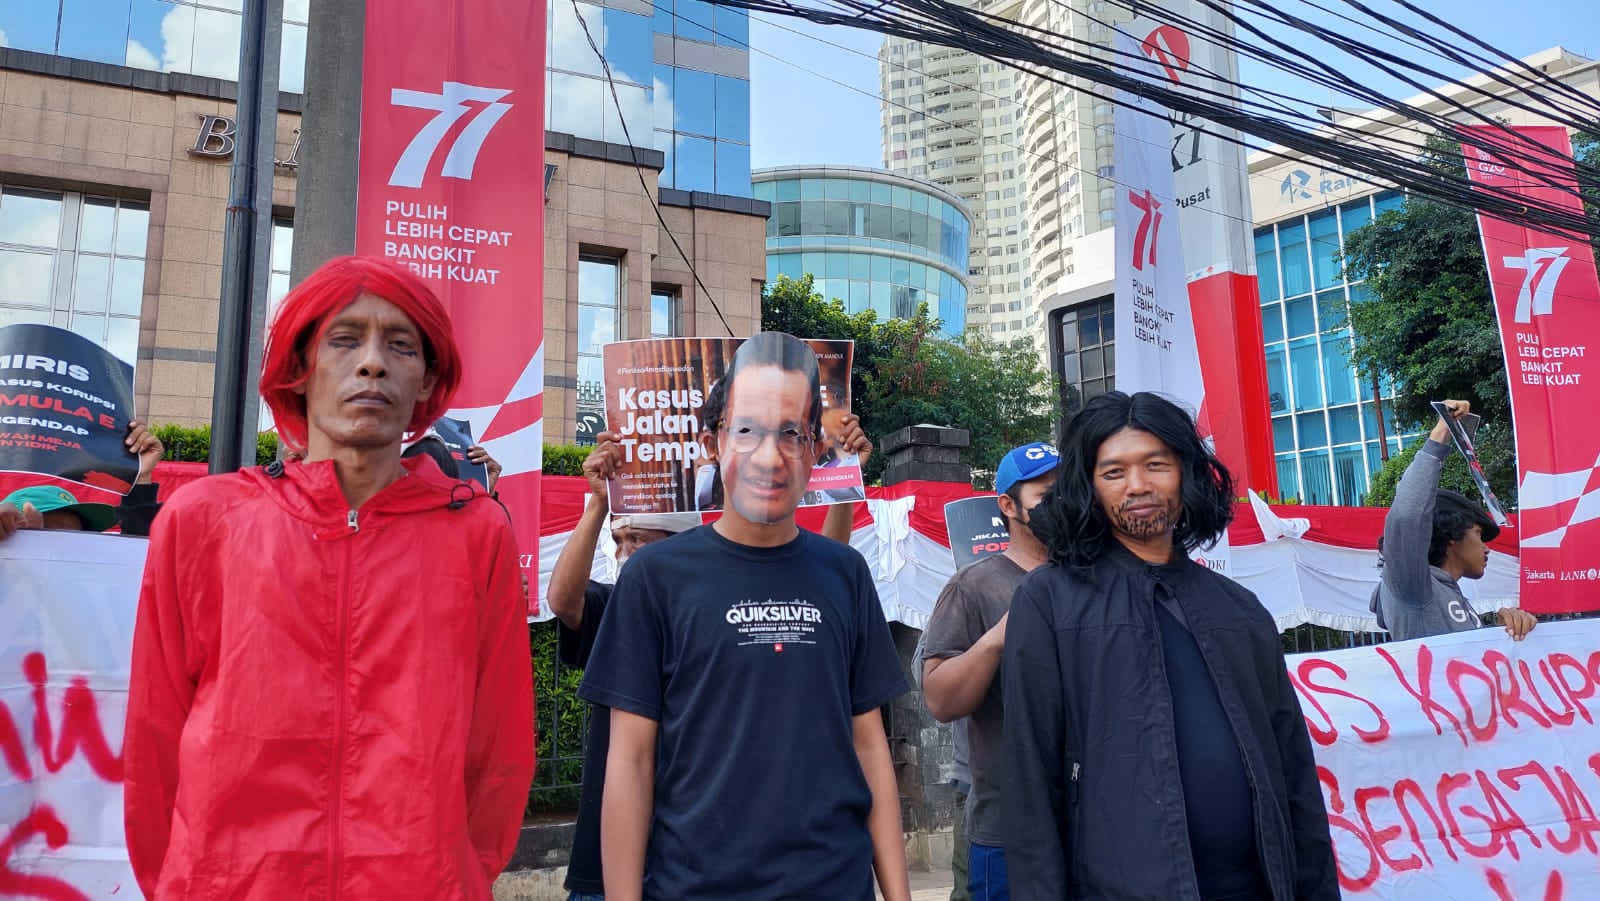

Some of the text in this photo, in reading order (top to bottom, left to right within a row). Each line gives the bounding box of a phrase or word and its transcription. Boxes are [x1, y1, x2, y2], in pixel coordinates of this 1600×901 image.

[387, 81, 514, 189] 77
[386, 200, 448, 221] PULIH
[384, 219, 513, 248] LEBIH CEPAT
[384, 241, 476, 265] BANGKIT
[397, 261, 500, 285] BIH KUAT
[1132, 278, 1154, 299] PULIH
[1503, 247, 1571, 324] 77
[1133, 295, 1154, 315] LEBIH
[1134, 327, 1156, 345] LEBIH
[1541, 346, 1586, 358] CEPAT
[1545, 373, 1582, 386] KUAT
[46, 382, 116, 411] KORUPSI
[618, 387, 704, 410] Kasus
[0, 416, 90, 436] GENDAP
[98, 413, 116, 430] E
[620, 410, 699, 436] Jalan
[971, 532, 999, 541] JIKA
[725, 605, 822, 624] QUIKSILVER
